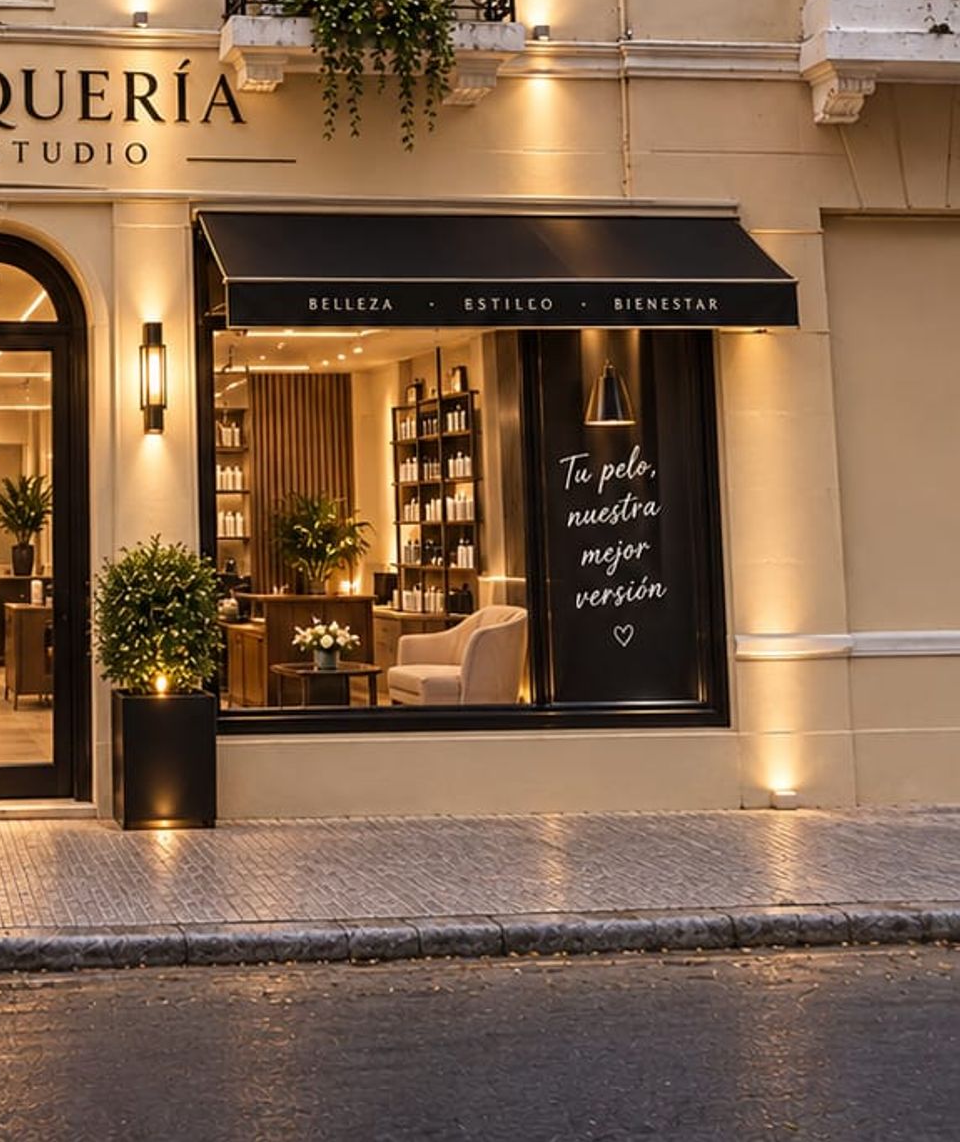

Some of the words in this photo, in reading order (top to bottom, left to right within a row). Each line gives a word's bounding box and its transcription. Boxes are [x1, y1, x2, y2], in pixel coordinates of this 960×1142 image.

[307, 296, 394, 312] BELLEZA
[613, 297, 720, 311] BIENESTAR
[559, 452, 593, 491] Tu
[597, 444, 656, 495] pelo,
[566, 491, 661, 528] nuestra
[580, 540, 651, 577] mejor
[575, 575, 667, 610] versión
